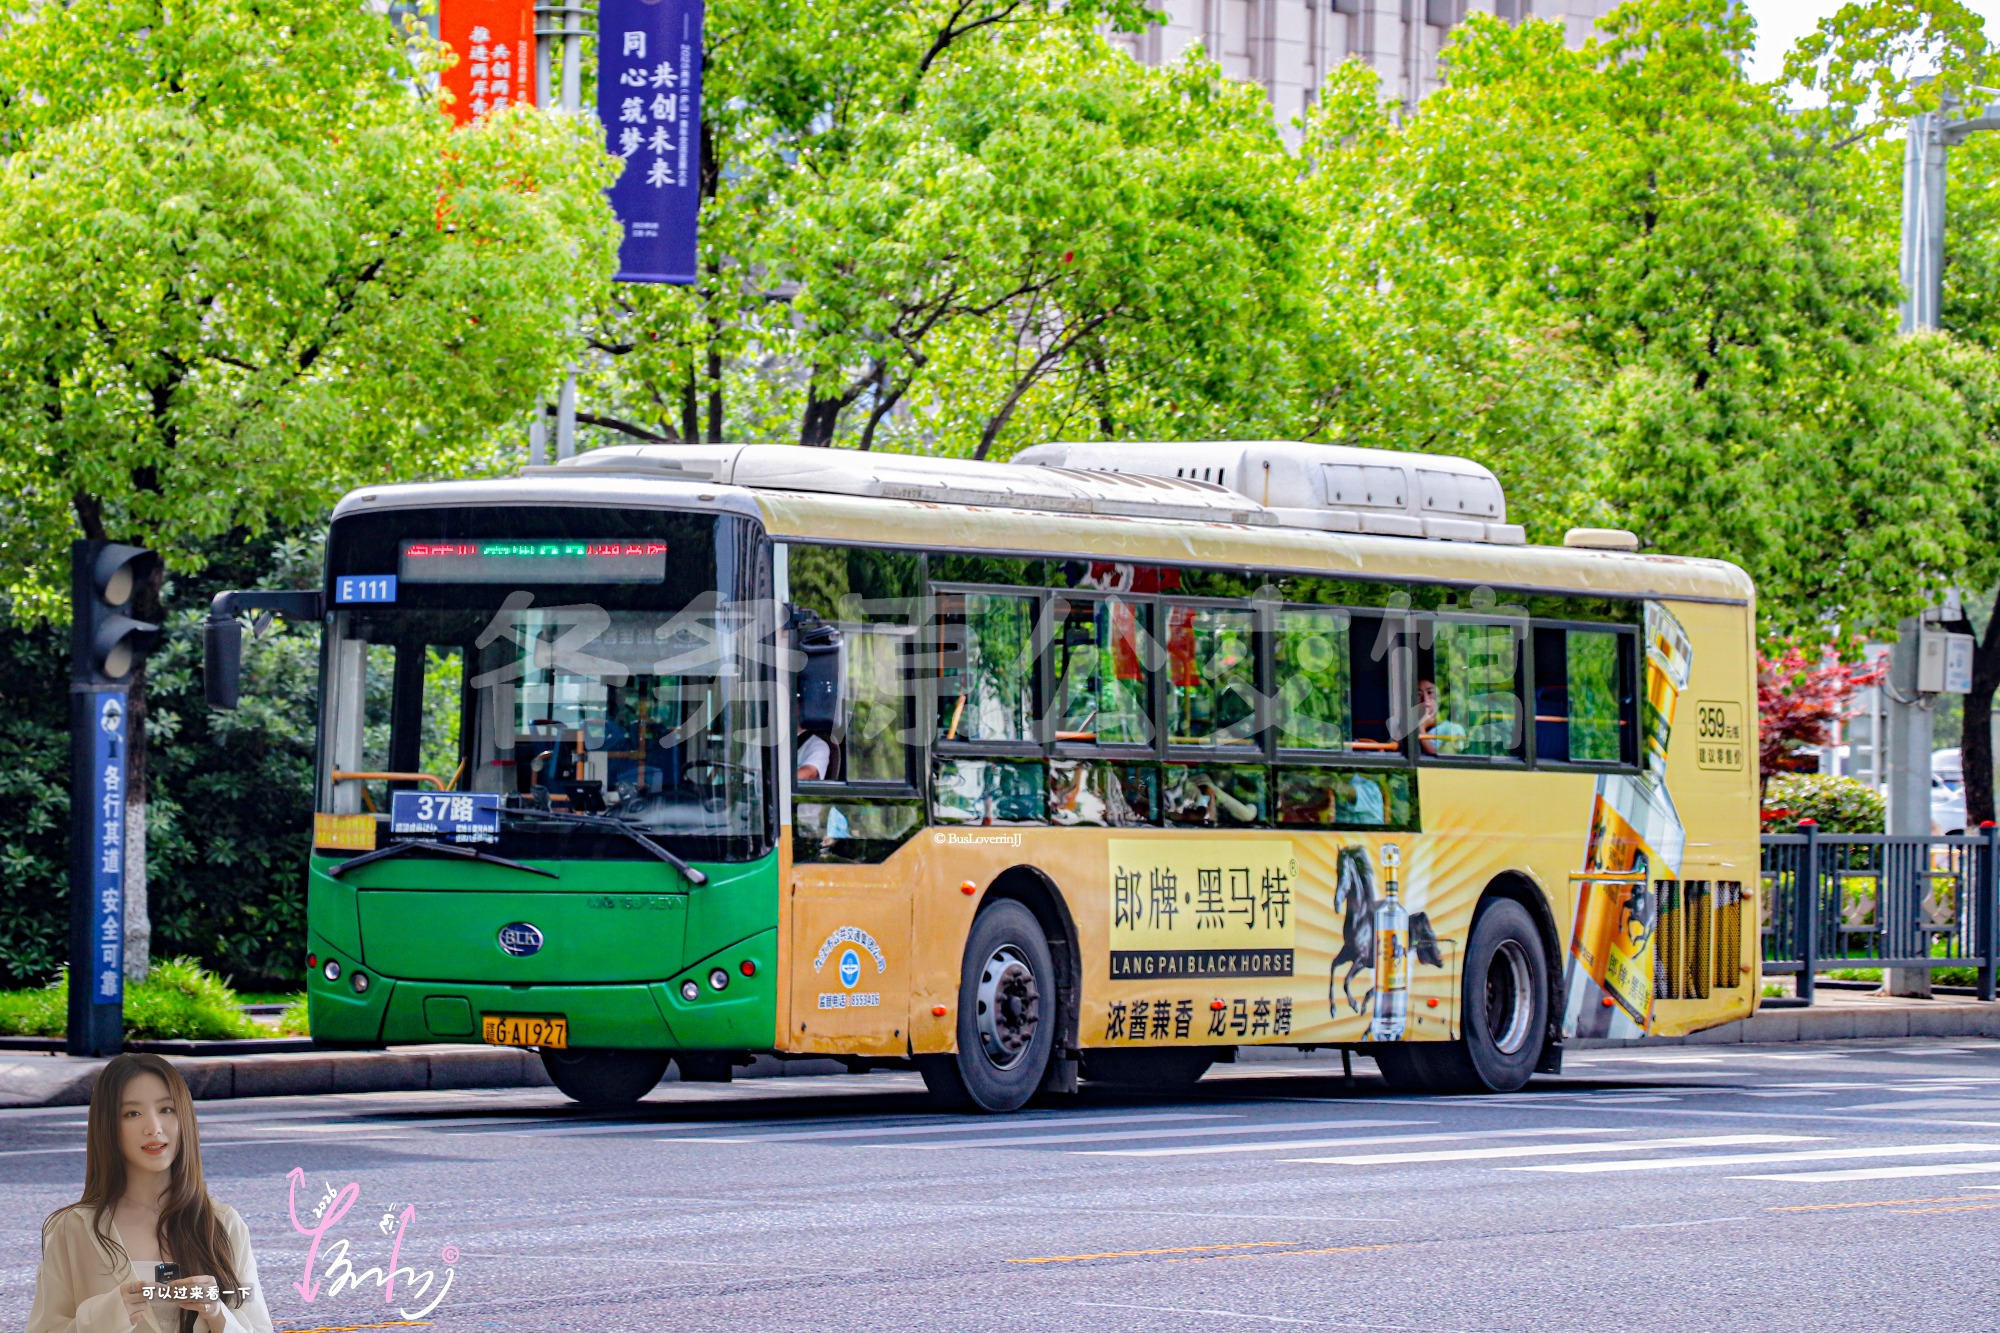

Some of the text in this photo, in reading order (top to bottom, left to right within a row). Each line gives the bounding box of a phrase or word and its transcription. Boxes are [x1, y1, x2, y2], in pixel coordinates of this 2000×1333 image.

[619, 31, 648, 158] 同心筑梦
[646, 61, 679, 188] 共创未来
[342, 580, 387, 601] E 111
[417, 796, 473, 821] 37路
[101, 765, 120, 996] 各行其道 安全可靠
[1114, 866, 1290, 932] 郎牌·黑马特
[505, 931, 537, 945] BLK
[1112, 953, 1292, 975] LANG PAI BLACK HORSE
[1105, 996, 1293, 1040] 浓酱兼香 龙马奔腾
